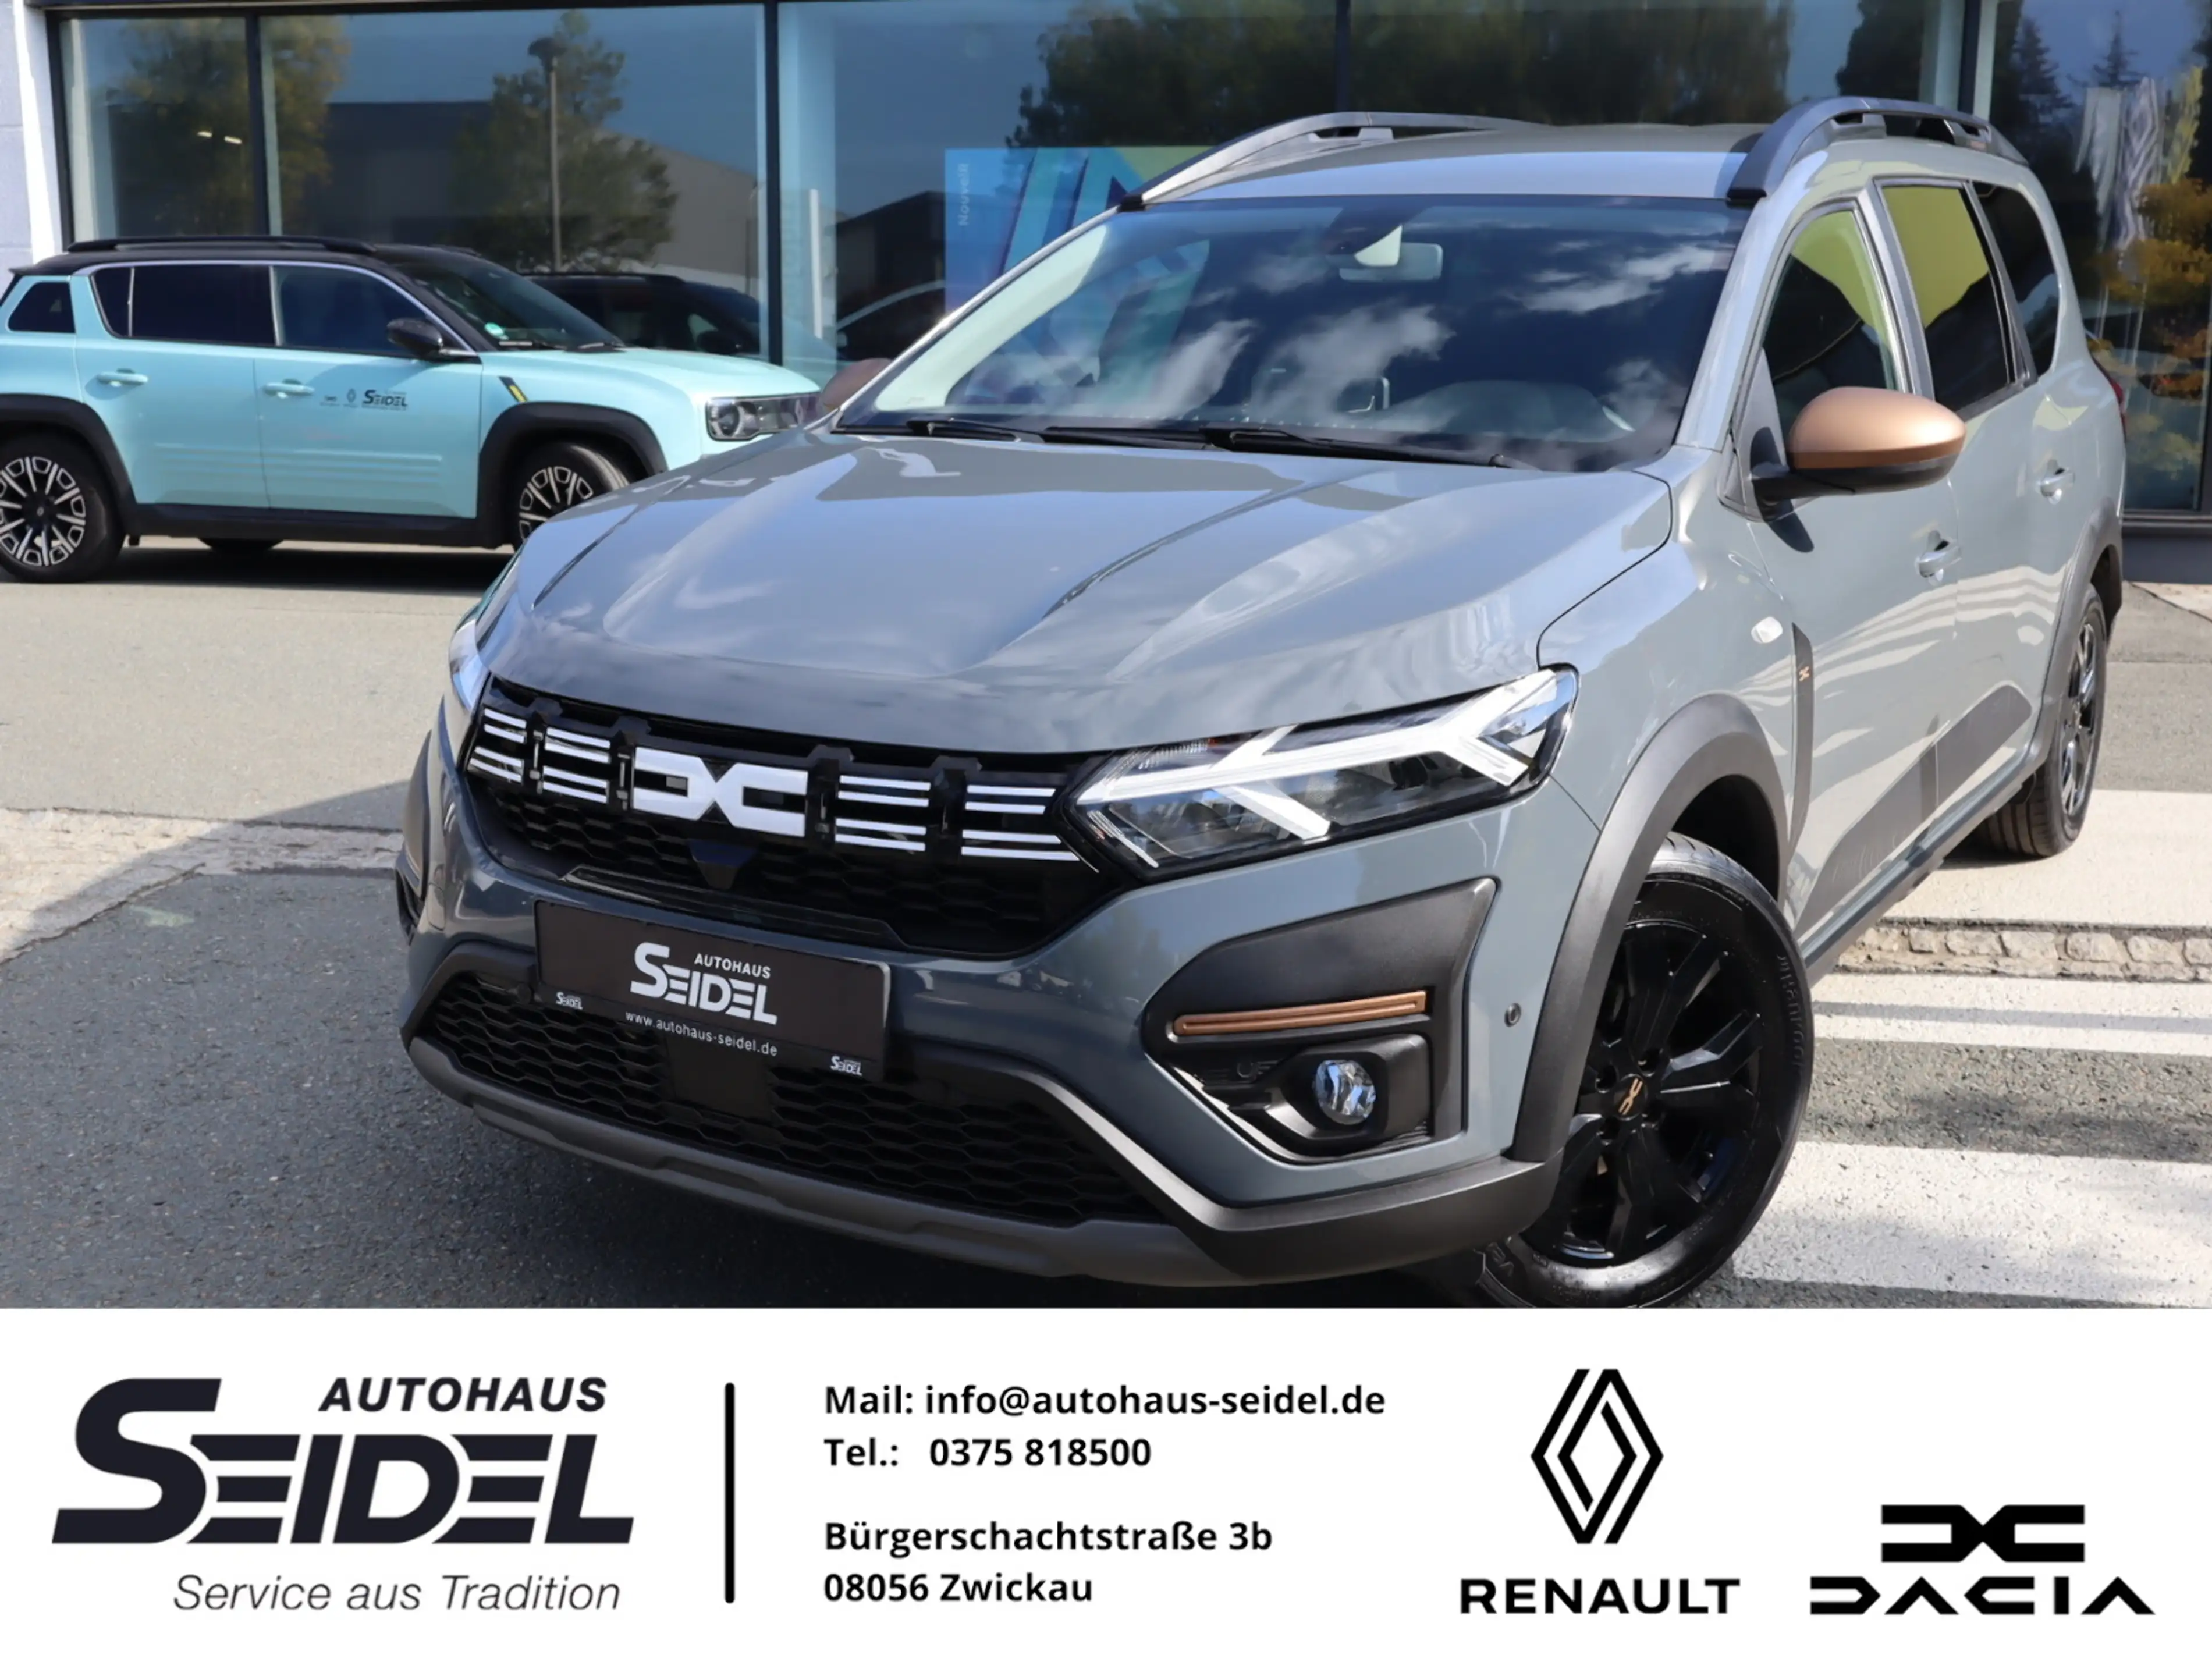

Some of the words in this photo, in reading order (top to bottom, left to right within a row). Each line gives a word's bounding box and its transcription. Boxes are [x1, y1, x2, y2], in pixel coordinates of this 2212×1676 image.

[630, 942, 777, 1025] SEIDEL
[694, 953, 771, 979] AUTOHAUS
[625, 1011, 778, 1056] www.autohaus-seidel.de
